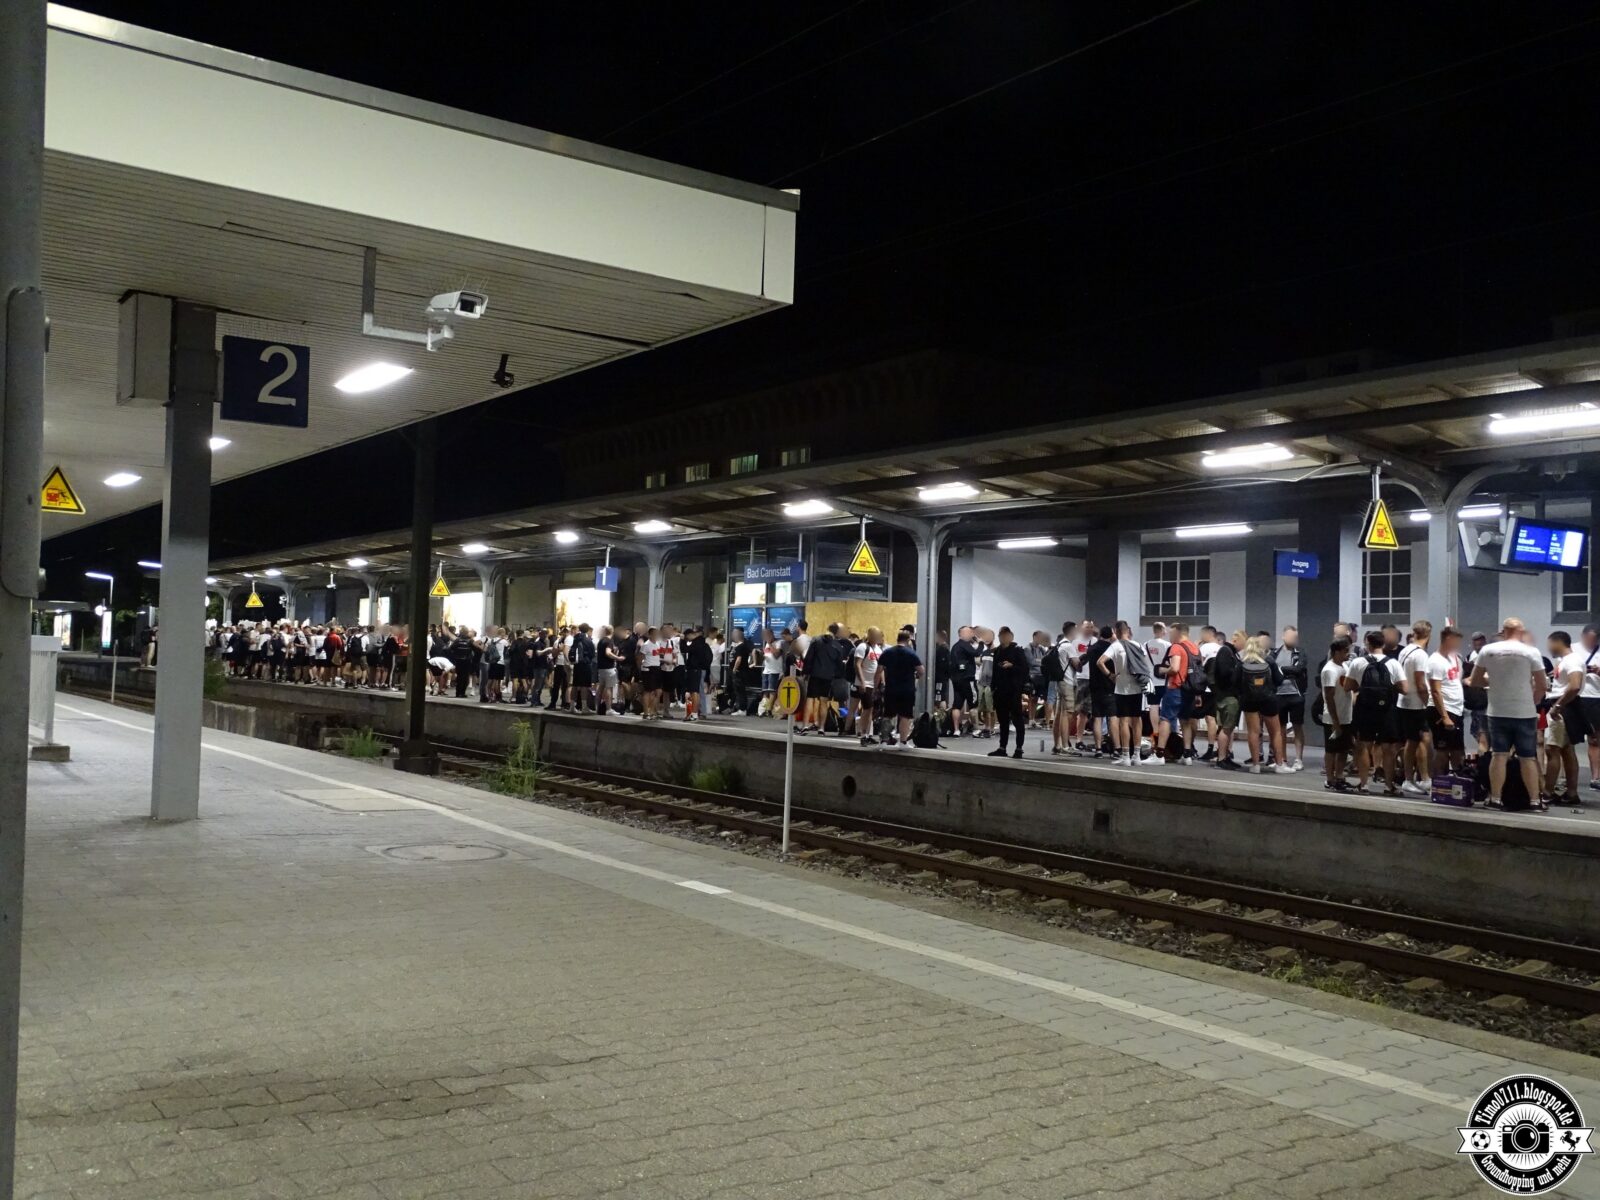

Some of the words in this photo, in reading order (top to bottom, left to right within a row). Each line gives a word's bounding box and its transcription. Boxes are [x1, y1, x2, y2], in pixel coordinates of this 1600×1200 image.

[257, 345, 297, 407] 2
[599, 567, 607, 586] 1
[746, 567, 759, 579] Bad
[760, 566, 791, 578] Cannstatt
